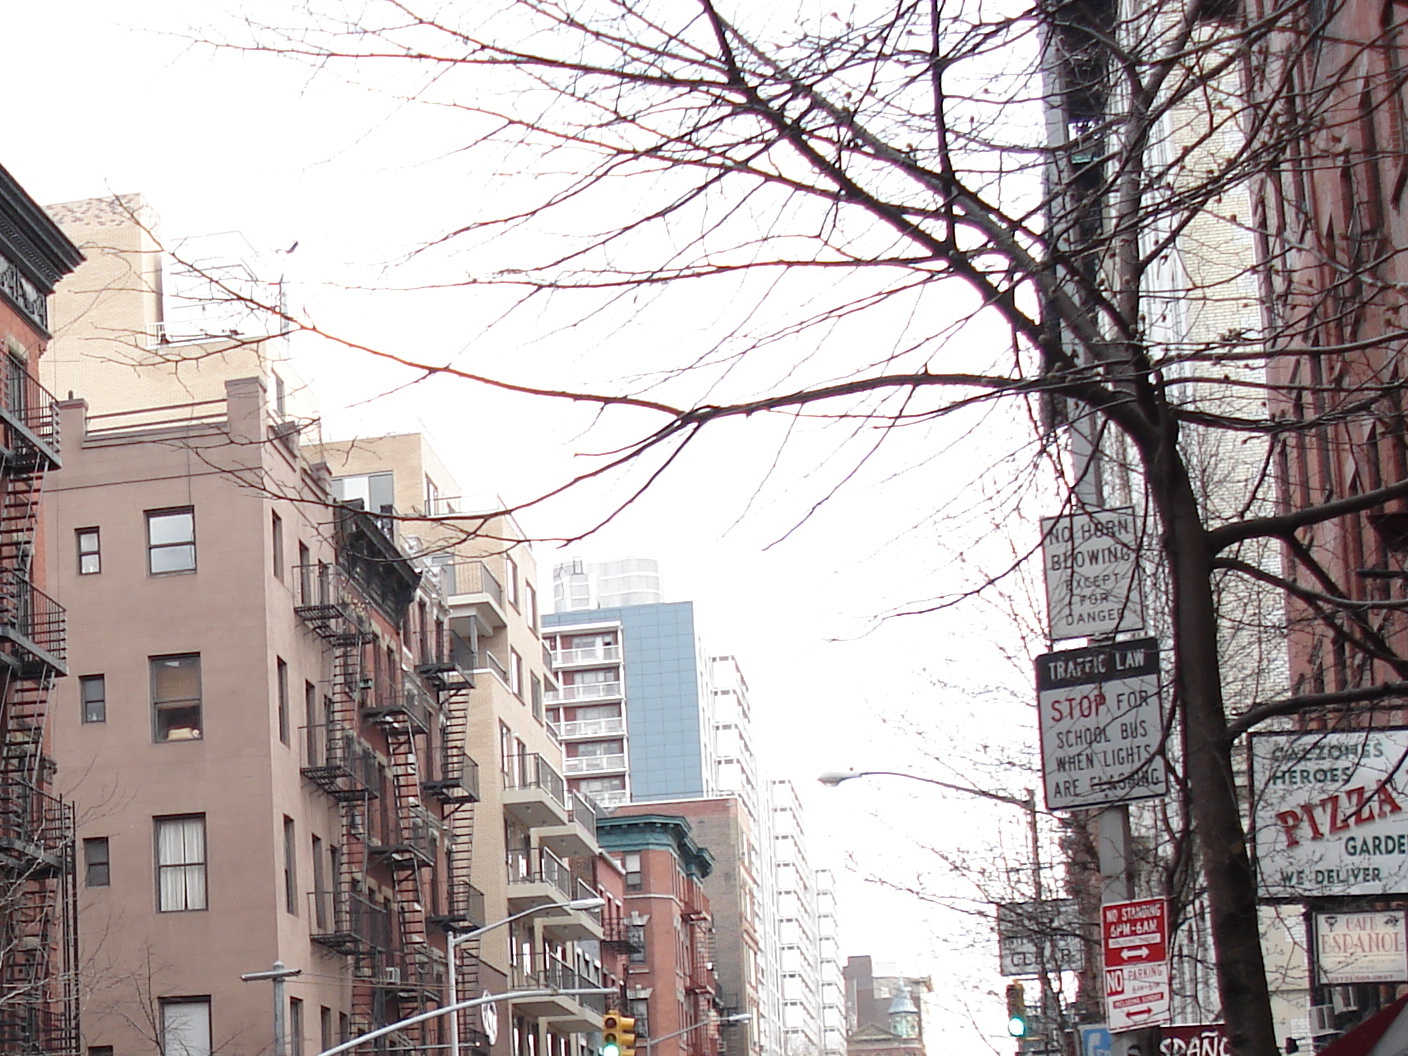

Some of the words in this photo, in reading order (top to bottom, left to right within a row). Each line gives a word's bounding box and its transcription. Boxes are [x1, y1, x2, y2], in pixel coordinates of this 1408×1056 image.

[1048, 526, 1072, 546] NO
[1081, 518, 1130, 541] HORN
[1051, 546, 1131, 572] BLOWING
[1066, 572, 1120, 590] EXCEPT
[1079, 593, 1109, 606] FOR
[1048, 654, 1108, 681] TRAFFIC
[1115, 649, 1145, 671] LAW
[1051, 693, 1107, 723] STOP
[1117, 690, 1150, 711] FOR
[1056, 727, 1111, 749] SCHOOL
[1121, 720, 1148, 740] BUS
[1056, 751, 1094, 774] WHEN
[1104, 744, 1151, 768] LIGHTS
[1272, 742, 1384, 762] CALZONES
[1272, 766, 1351, 786] HEROES
[1053, 779, 1079, 799] ARE
[1276, 779, 1403, 849] PIZZA
[1345, 834, 1408, 857] GARDE
[1282, 869, 1304, 885] WE
[1315, 867, 1382, 884] DELIVER
[1106, 910, 1119, 922] NO
[1121, 904, 1161, 921] STANDING
[1107, 970, 1123, 993] NO
[1128, 965, 1163, 981] PARKING
